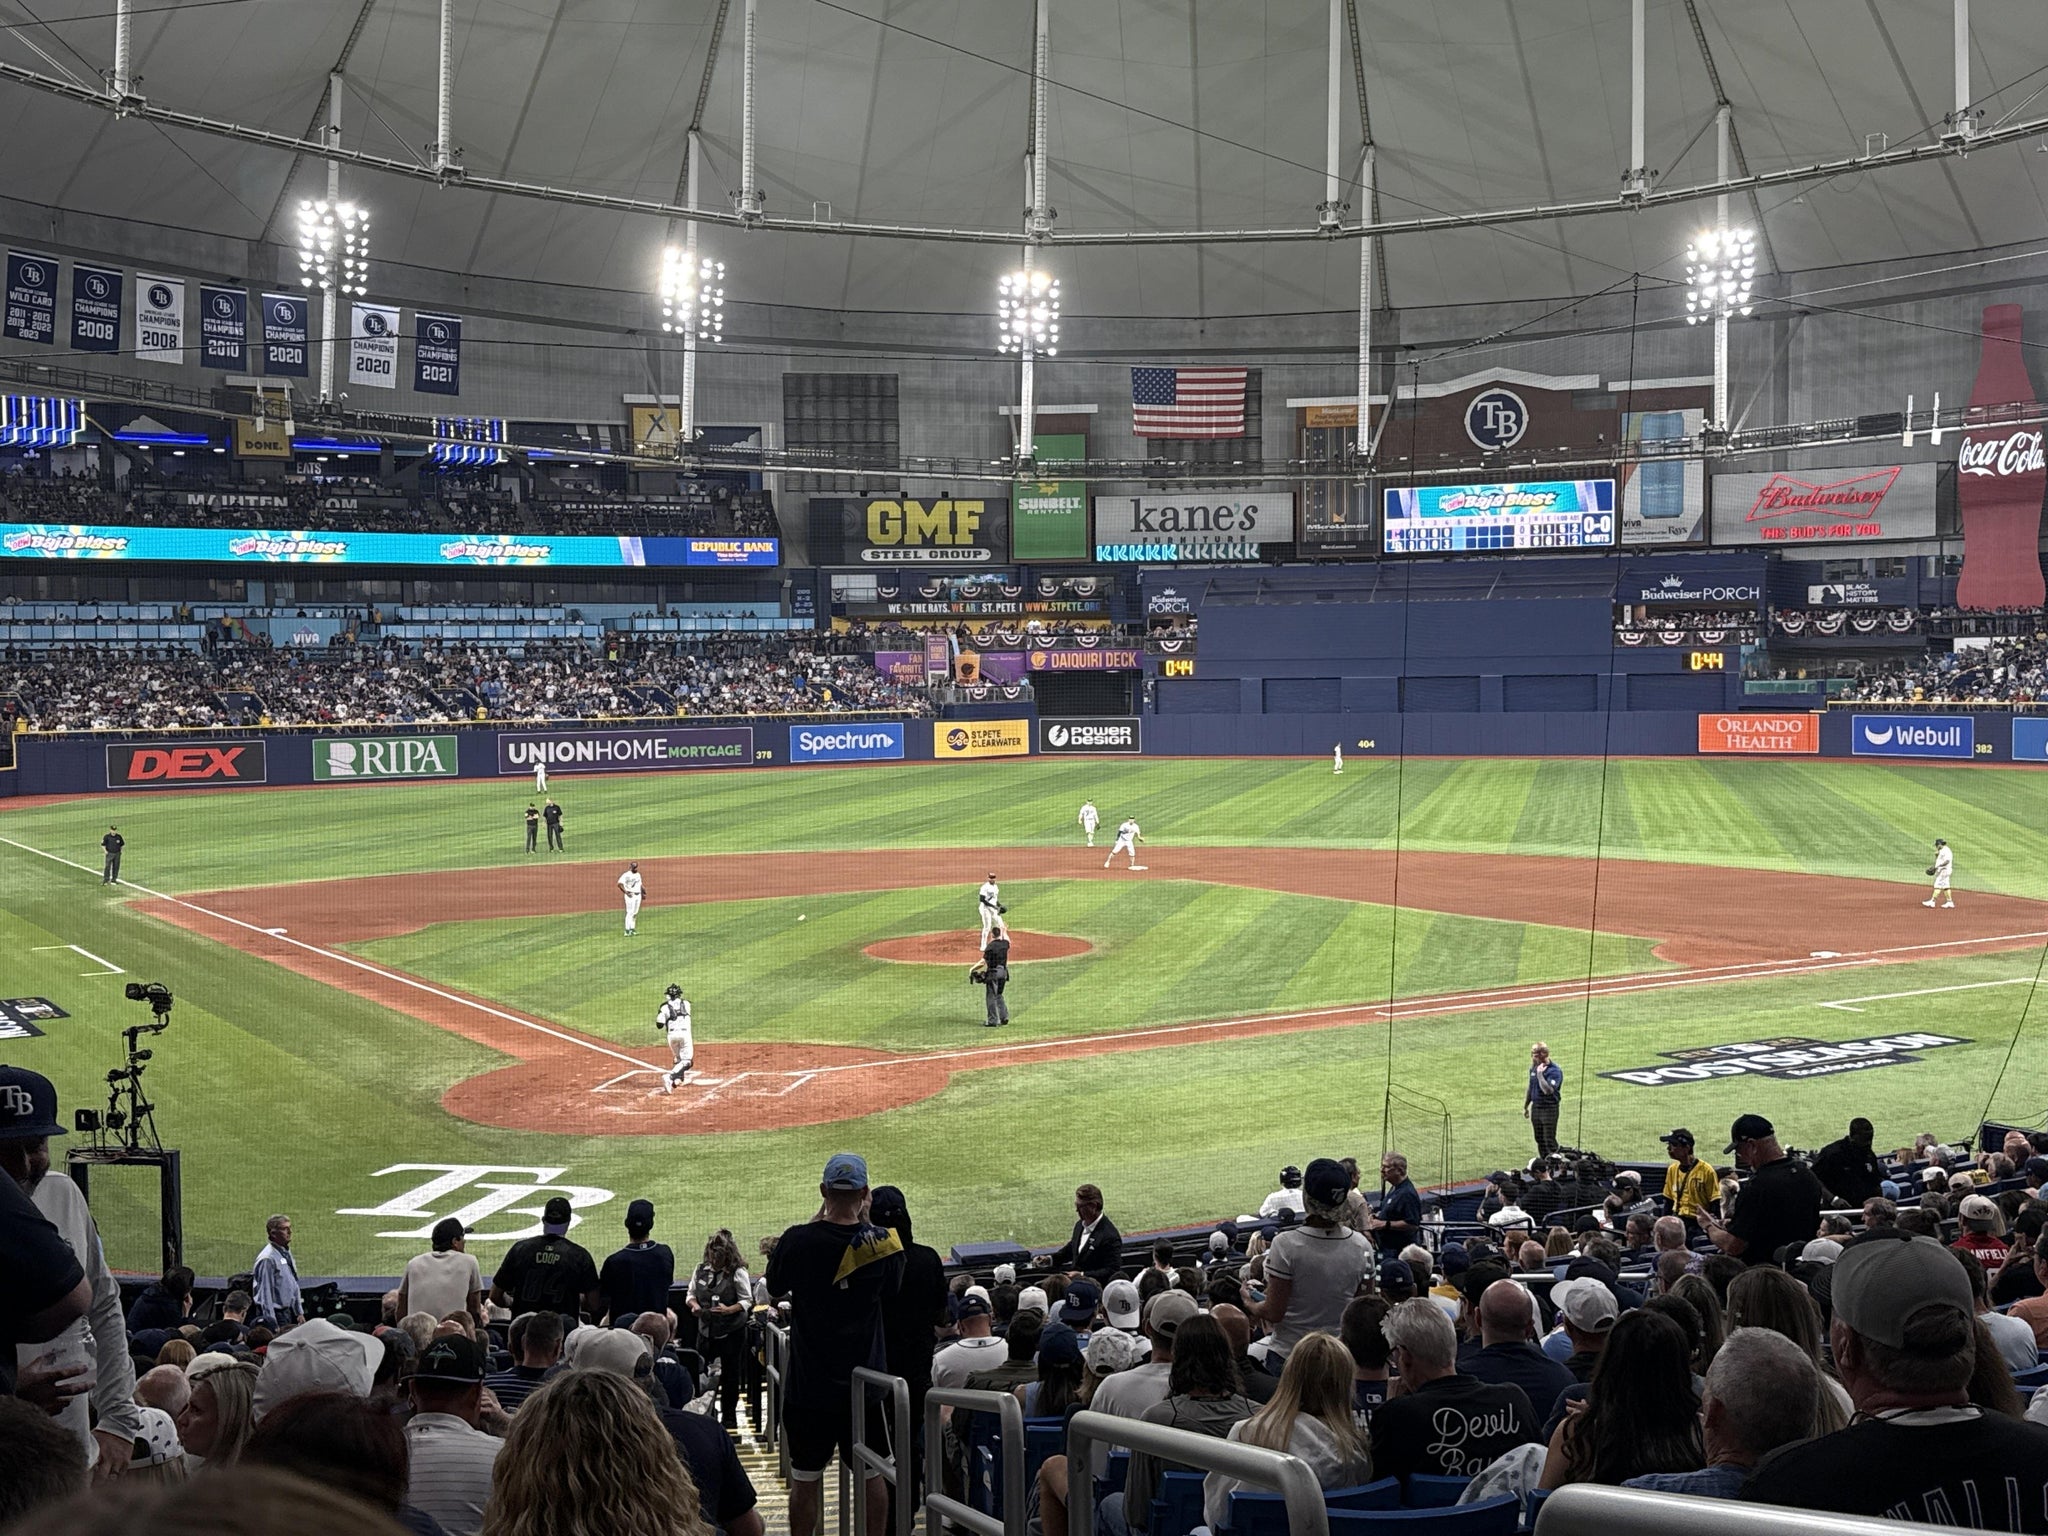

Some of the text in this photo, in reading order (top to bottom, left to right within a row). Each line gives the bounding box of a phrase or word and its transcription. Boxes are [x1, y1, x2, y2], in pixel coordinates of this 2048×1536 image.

[25, 266, 40, 283] TB
[90, 279, 105, 295] TB
[10, 291, 52, 307] WILD CARD
[153, 290, 168, 304] TB
[75, 303, 118, 318] CHAMPIONS
[217, 299, 231, 313] TB
[278, 306, 292, 320] TB
[10, 307, 50, 322] 2011 2013
[139, 314, 180, 327] CHAMPIONS
[19, 329, 39, 339] 2023
[32, 321, 52, 332] 2022
[78, 320, 113, 340] 2008
[204, 323, 244, 336] CHAMPIONS
[143, 331, 177, 348] 2008
[266, 330, 305, 341] CHAMPIONS
[209, 340, 239, 357] 2010
[354, 341, 394, 354] CHAMPIONS
[270, 347, 302, 364] 2020
[418, 350, 458, 361] CHAMPIONS
[357, 357, 390, 374] 2020
[422, 365, 451, 382] 2021
[1477, 401, 1518, 438] TB
[245, 441, 283, 450] DONE.
[1959, 432, 2045, 476] Coca-Cola
[297, 462, 322, 475] EATS
[1505, 492, 1557, 506] Blast
[1760, 486, 1884, 510] Budweiser
[867, 500, 985, 545] GMF
[1130, 498, 1258, 533] kane's
[1583, 516, 1610, 533] 0-0
[1668, 526, 1687, 535] Rays
[1760, 527, 1785, 539] THIS
[1790, 526, 1824, 538] BUD'S
[1829, 524, 1851, 536] FOR
[31, 536, 74, 551] Baja
[75, 536, 128, 550] Blast
[1143, 536, 1246, 544] FURNITURE
[1591, 534, 1610, 542] OUTS
[256, 541, 296, 555] Baja
[297, 540, 347, 554] Blast
[466, 545, 504, 559] Baja
[504, 544, 551, 558] Blast
[691, 542, 774, 552] REPUBLIC BANK
[871, 550, 982, 560] STEEL GROUP
[1641, 587, 1760, 600] Budweiser PORCH
[888, 604, 901, 613] WE
[910, 604, 926, 613] THE
[928, 603, 950, 613] RAYS.
[952, 603, 964, 613] WE
[1149, 603, 1189, 613] PORCH
[909, 655, 922, 663] FAN
[1051, 651, 1136, 668] DAIQUIRI DECK
[1691, 652, 1723, 670] 0:44
[890, 665, 922, 674] FAVORITE
[1166, 660, 1193, 676] 0:44
[800, 731, 889, 755] Spectrum
[972, 738, 1021, 747] CLEARWATER
[1358, 740, 1375, 748] 404
[1896, 726, 1960, 747] Webull
[668, 744, 742, 758] MORTGAGE
[756, 750, 772, 760] 378
[1975, 744, 1992, 753] 382
[128, 747, 245, 780] DEX
[359, 740, 446, 775] RIPA
[1611, 1034, 1960, 1085] POSTSEASON
[0, 1086, 34, 1116] TB
[334, 1164, 616, 1241] TB
[536, 1252, 560, 1264] COOP
[1068, 1292, 1080, 1307] TB
[1119, 1300, 1131, 1311] TB
[1426, 1402, 1520, 1454] Devil
